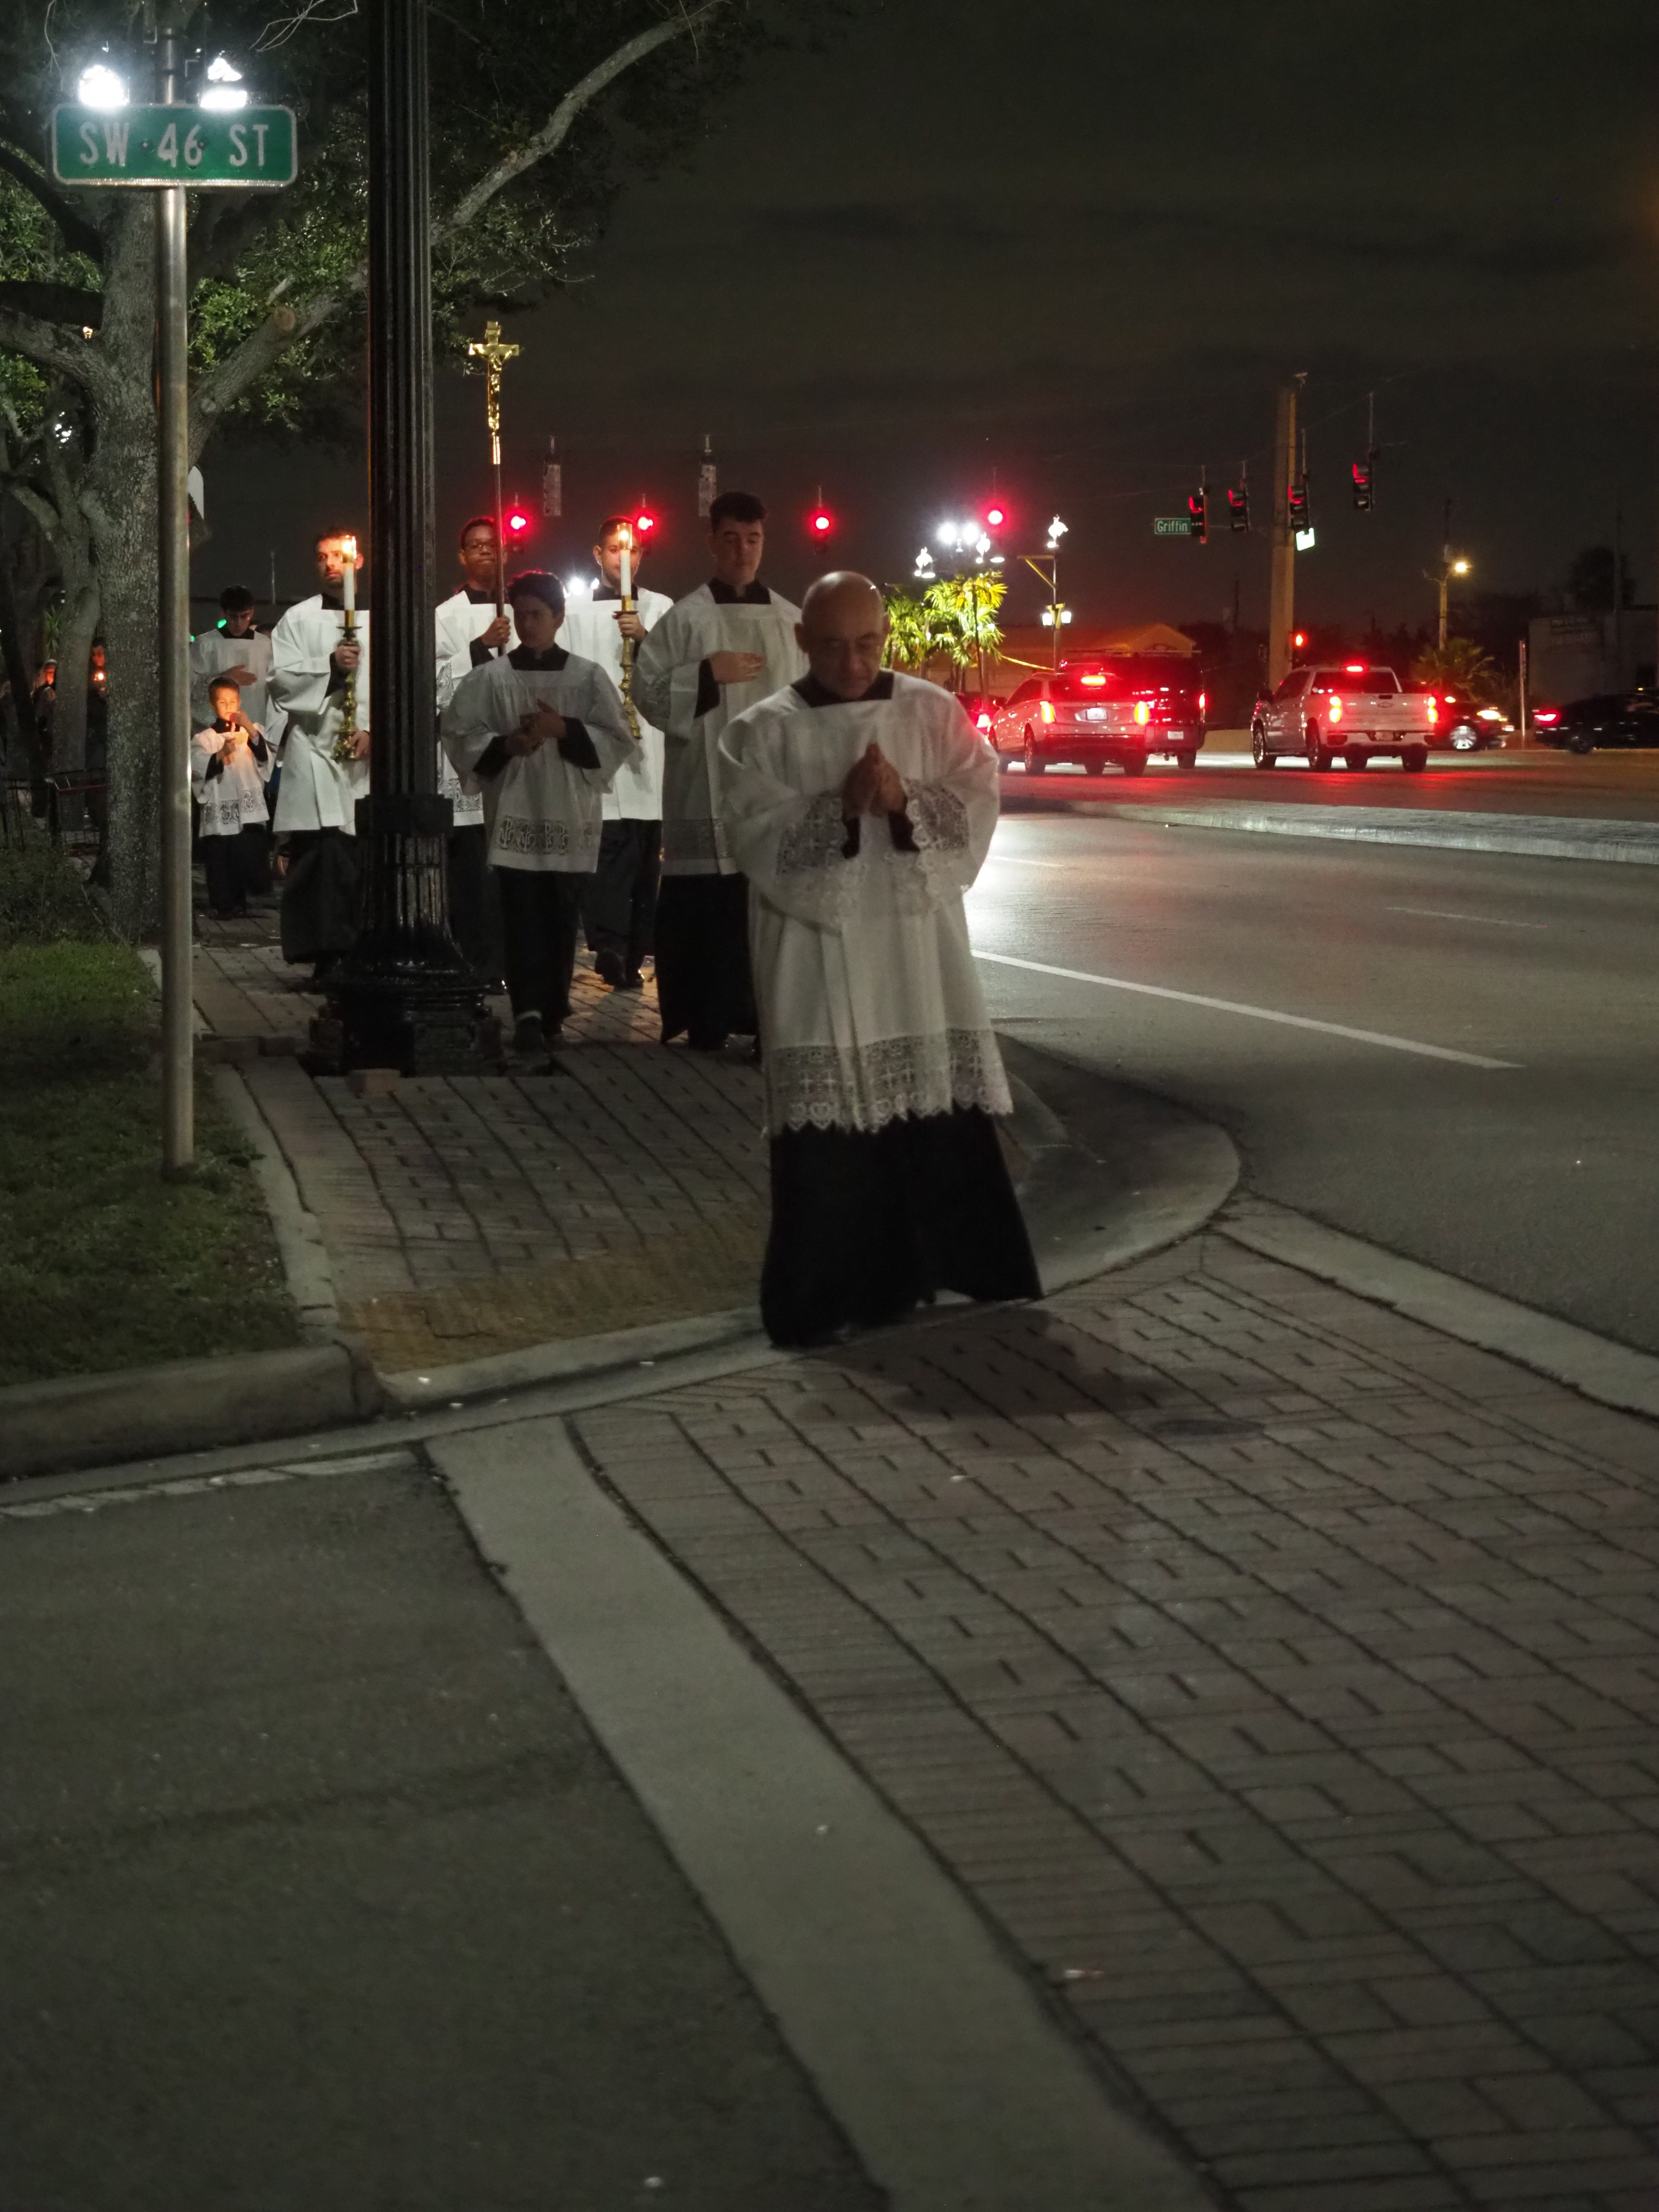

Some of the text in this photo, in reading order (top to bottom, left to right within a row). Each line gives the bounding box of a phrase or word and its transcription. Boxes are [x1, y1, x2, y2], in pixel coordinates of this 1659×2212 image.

[80, 122, 268, 167] SW 46 ST
[1157, 521, 1187, 532] Griffin
